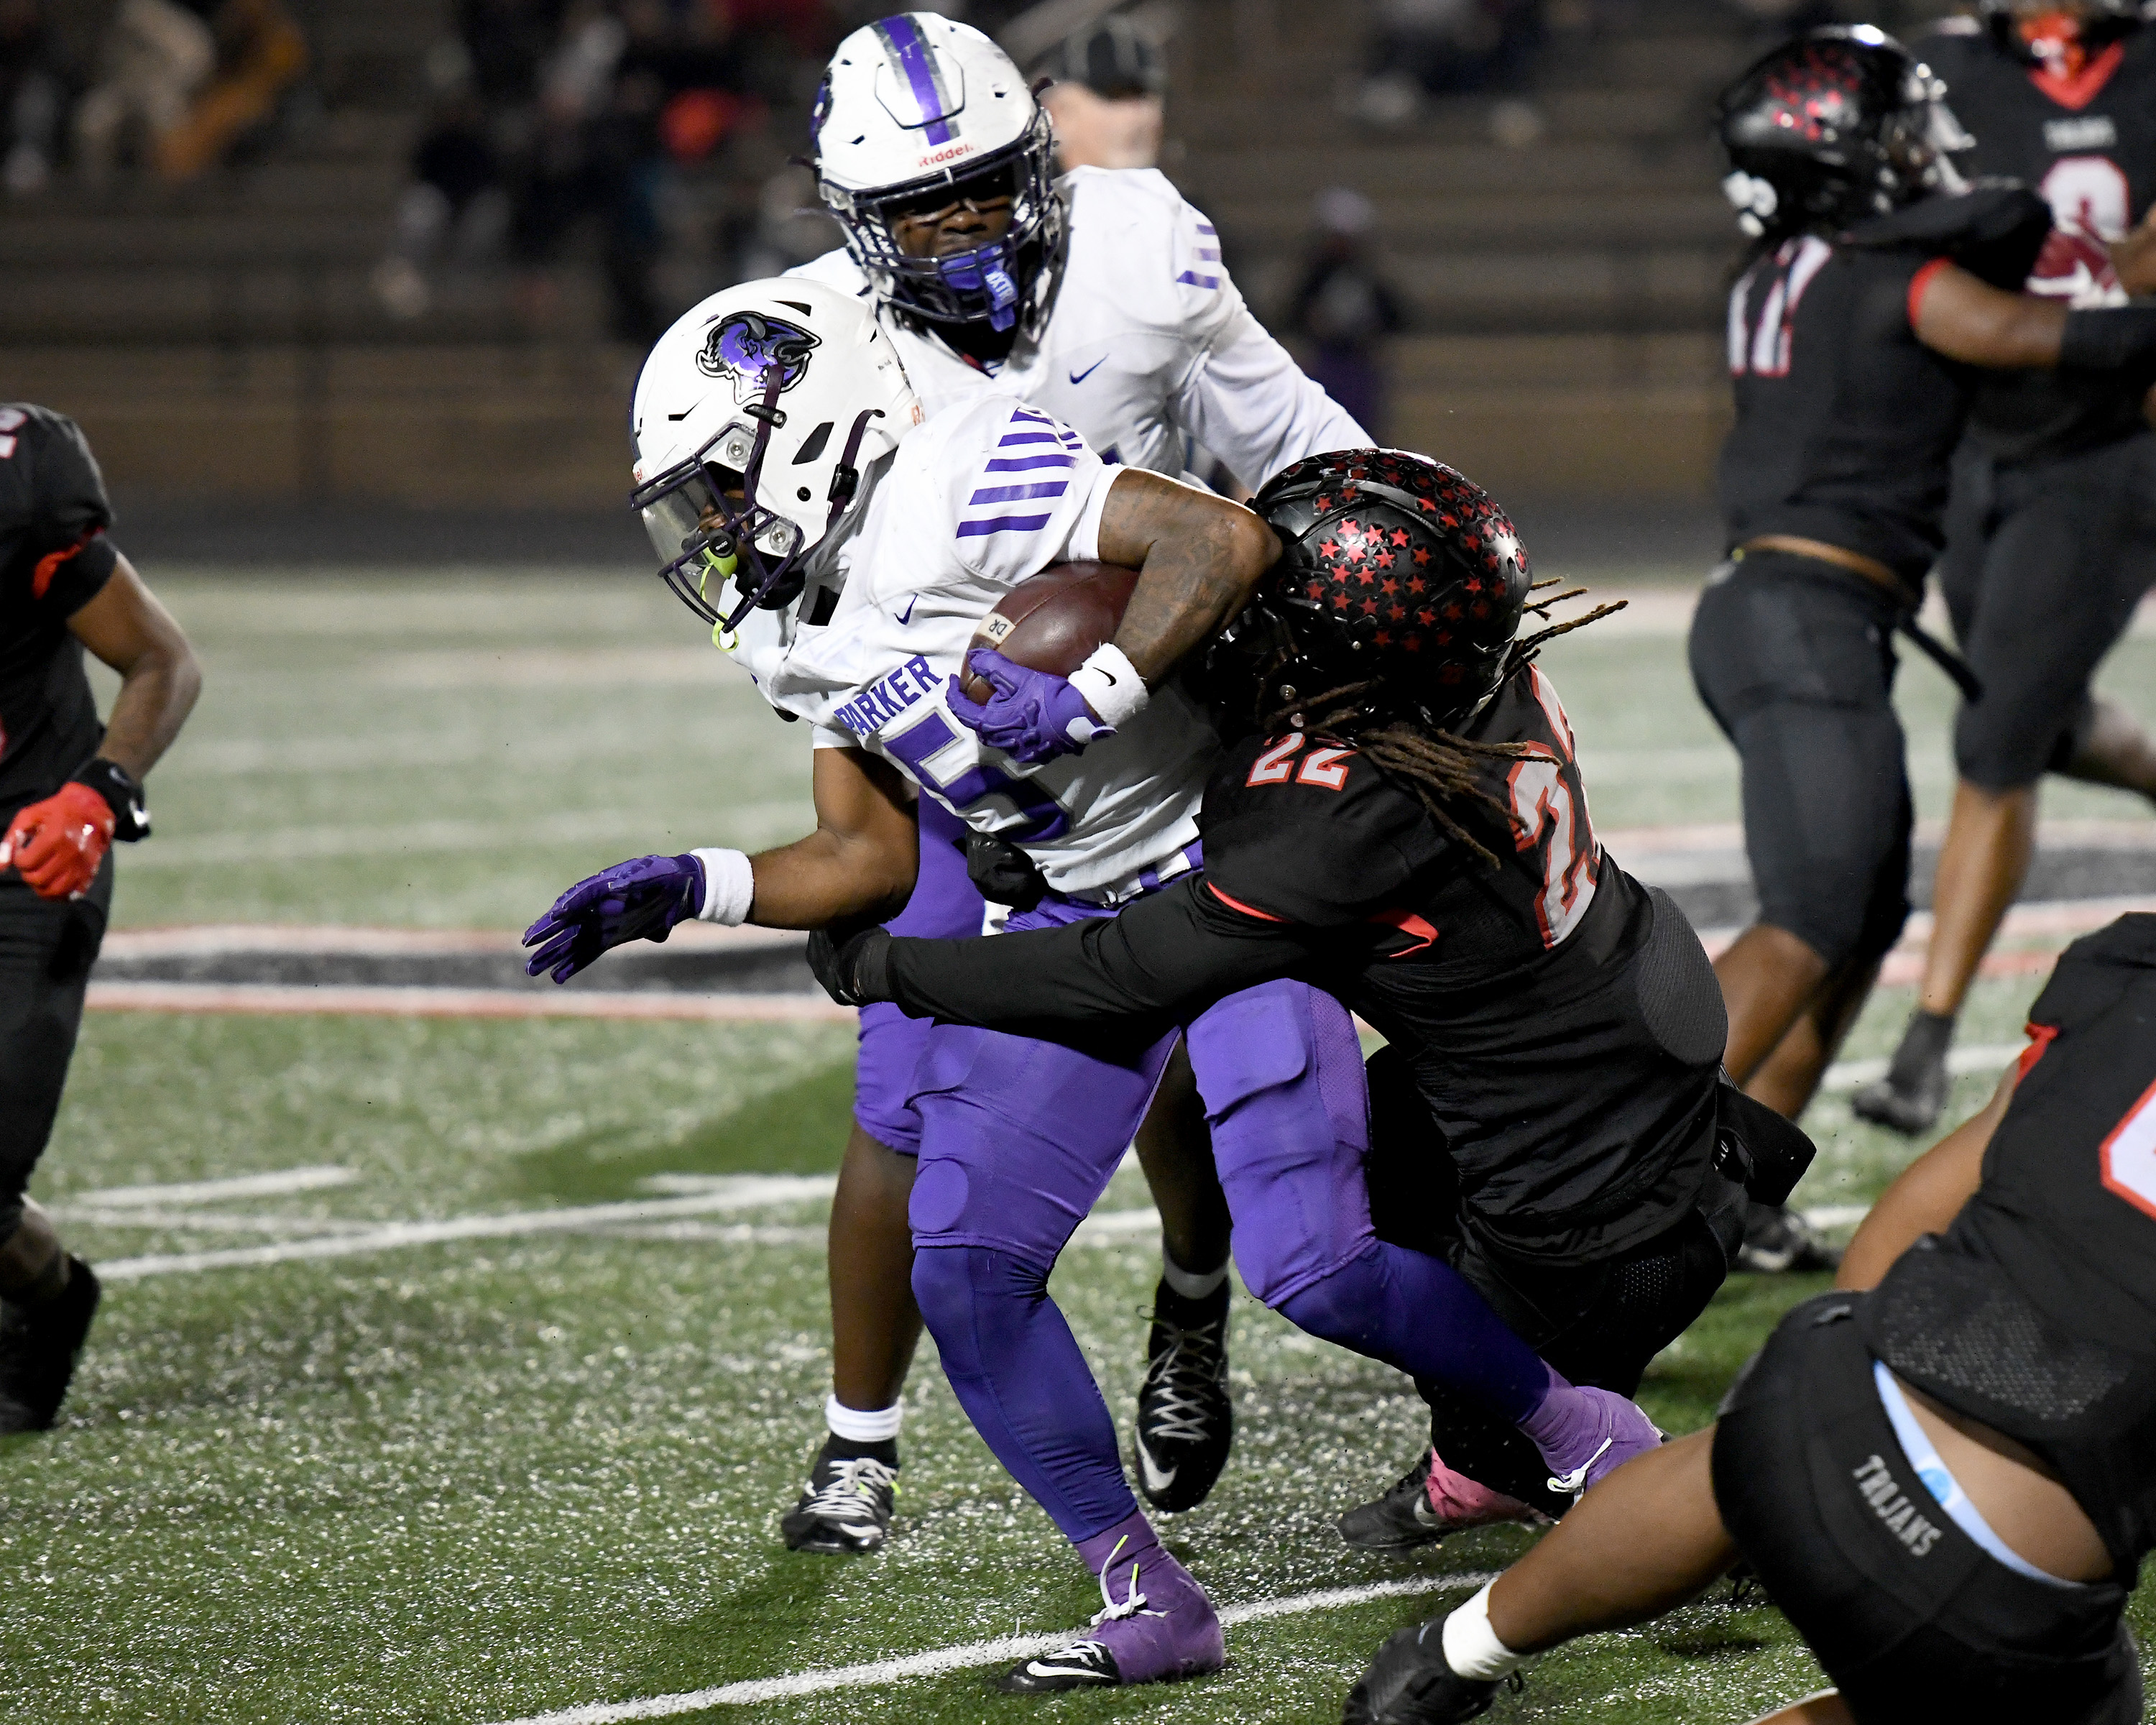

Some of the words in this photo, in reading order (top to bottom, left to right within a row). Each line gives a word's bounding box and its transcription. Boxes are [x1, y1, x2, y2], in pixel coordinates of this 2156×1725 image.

[919, 144, 974, 167] Riddel
[834, 654, 943, 735] PARKER
[880, 706, 1070, 843] 5
[1245, 732, 1357, 791] 22
[1852, 1454, 1942, 1557] TROJANS
